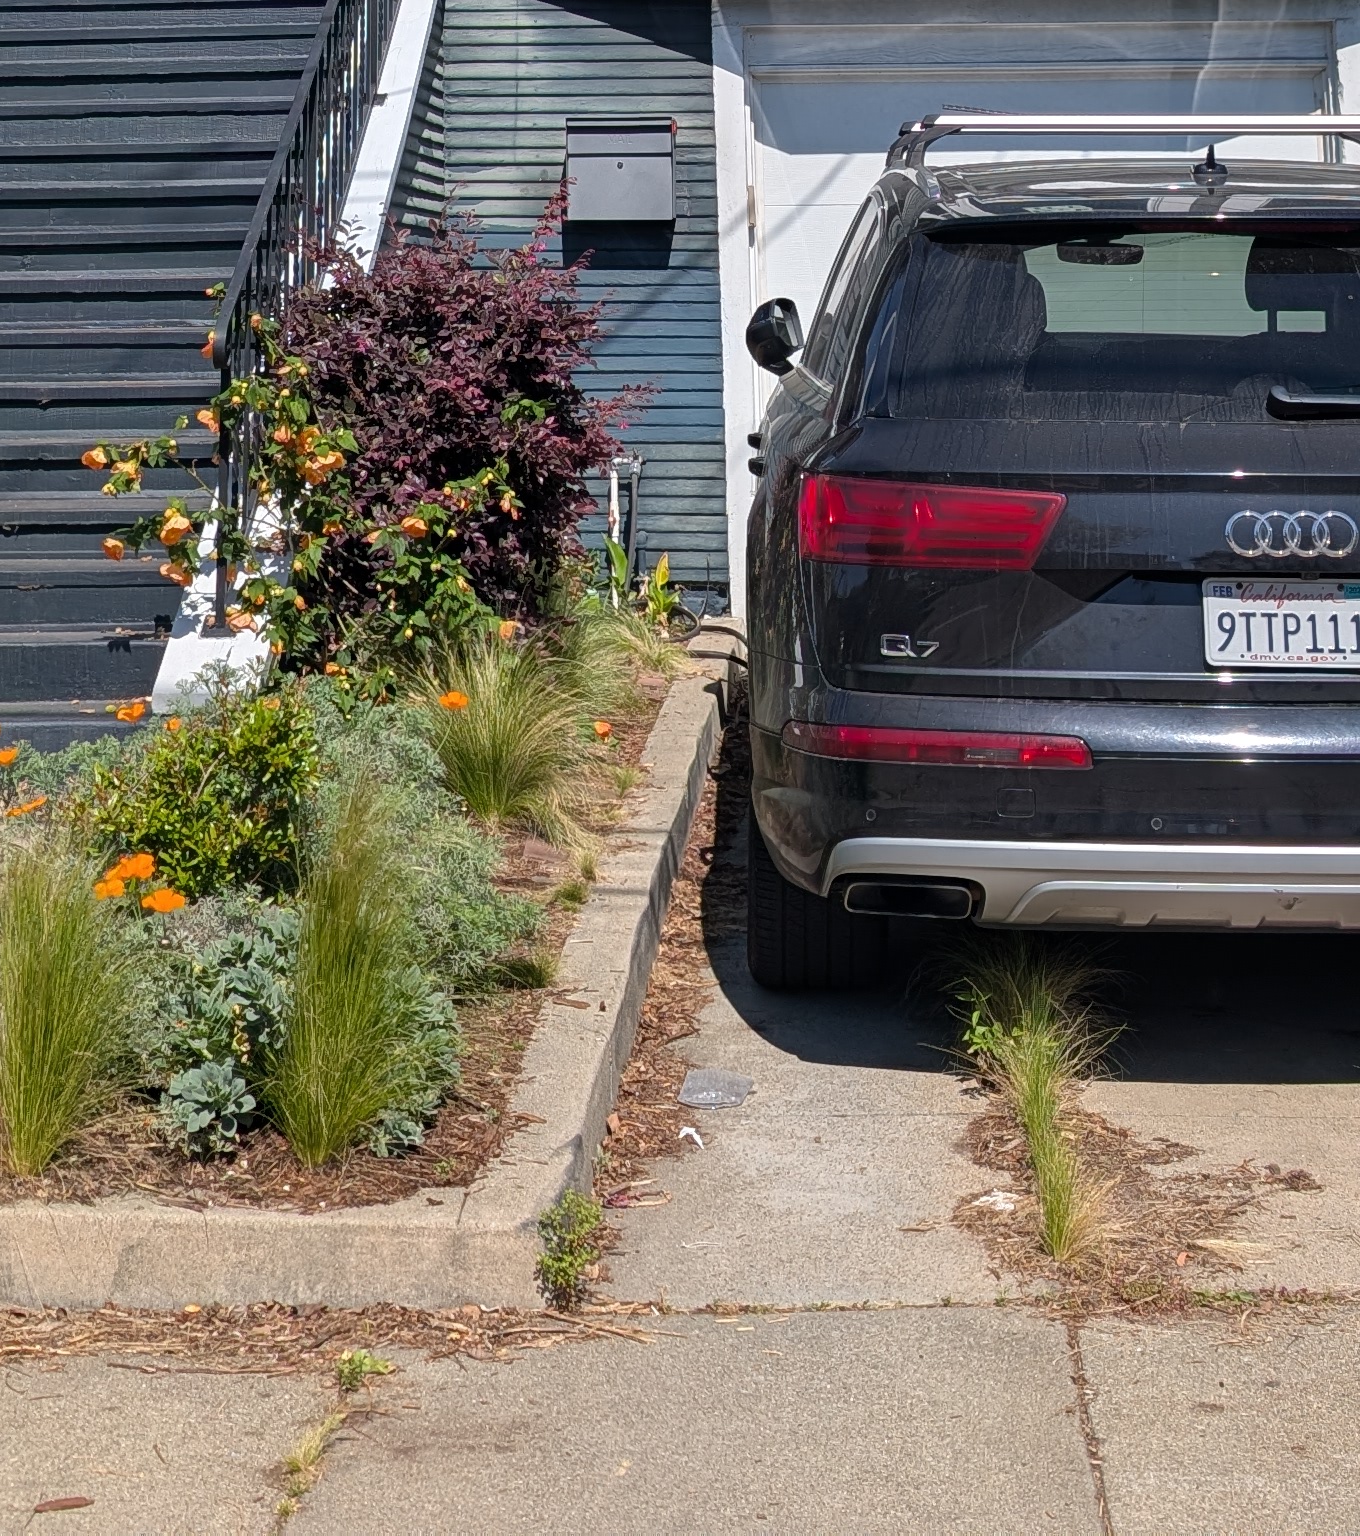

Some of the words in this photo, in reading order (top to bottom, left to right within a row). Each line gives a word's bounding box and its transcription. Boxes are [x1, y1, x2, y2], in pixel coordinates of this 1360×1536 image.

[607, 134, 633, 145] MAIL
[1212, 585, 1233, 598] FEB
[1240, 582, 1346, 610] California
[880, 633, 939, 658] Q7
[1249, 653, 1338, 663] dmv.ca.gov
